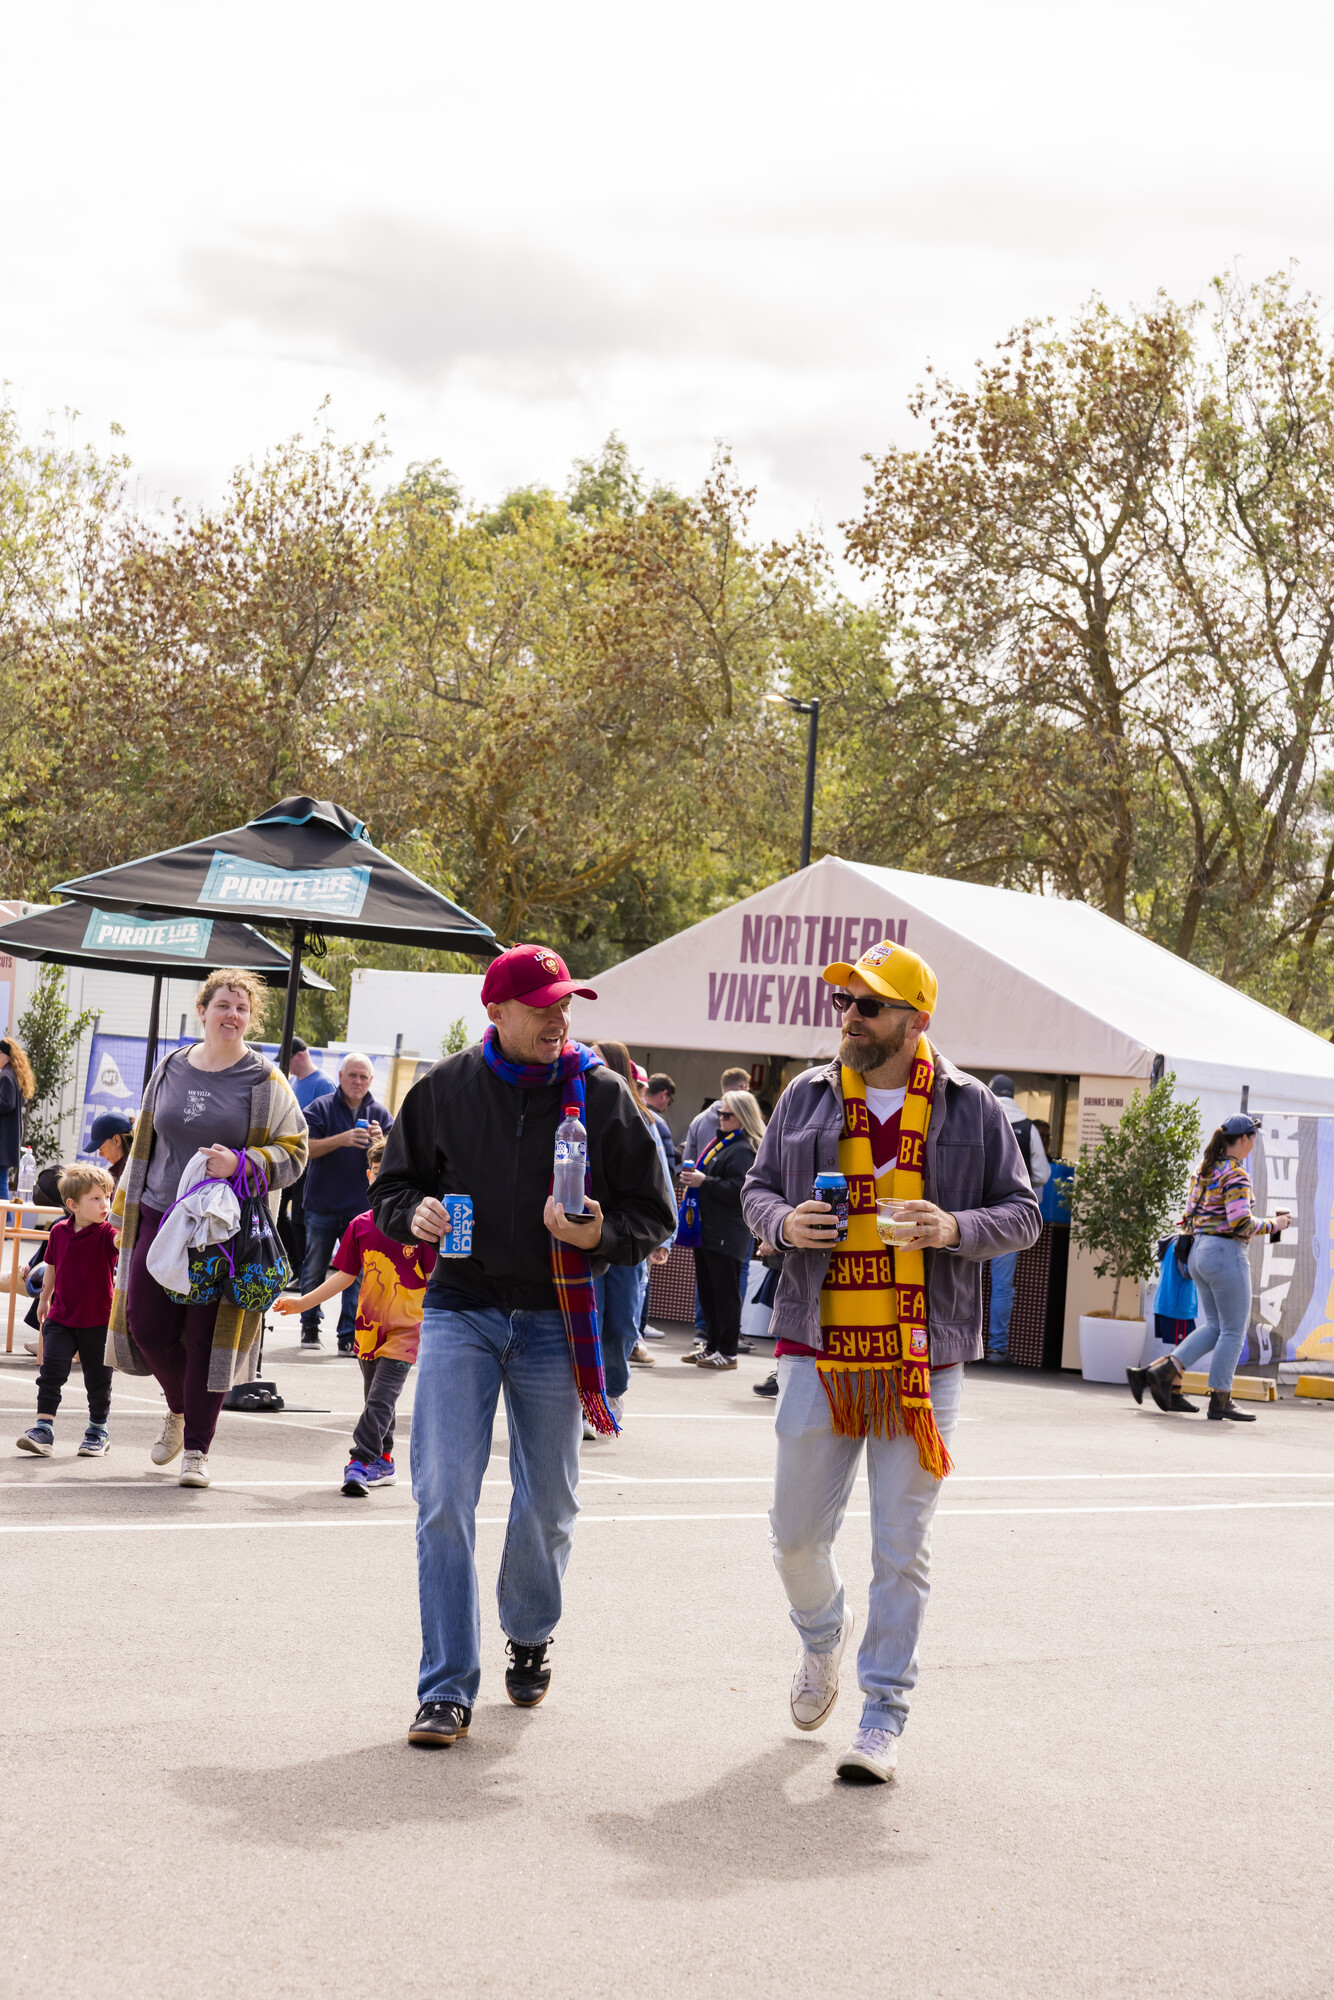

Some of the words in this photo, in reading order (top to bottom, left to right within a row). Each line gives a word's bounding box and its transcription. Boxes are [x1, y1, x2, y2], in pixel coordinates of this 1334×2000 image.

[708, 972, 845, 1028] VINEYAR
[103, 1072, 118, 1083] AFL
[1083, 1096, 1106, 1107] DRINKS
[1106, 1097, 1124, 1108] MENU
[452, 1203, 462, 1252] CARLTON
[461, 1203, 473, 1252] DRY
[826, 1255, 892, 1285] BEARS
[828, 1329, 900, 1358] BEARS
